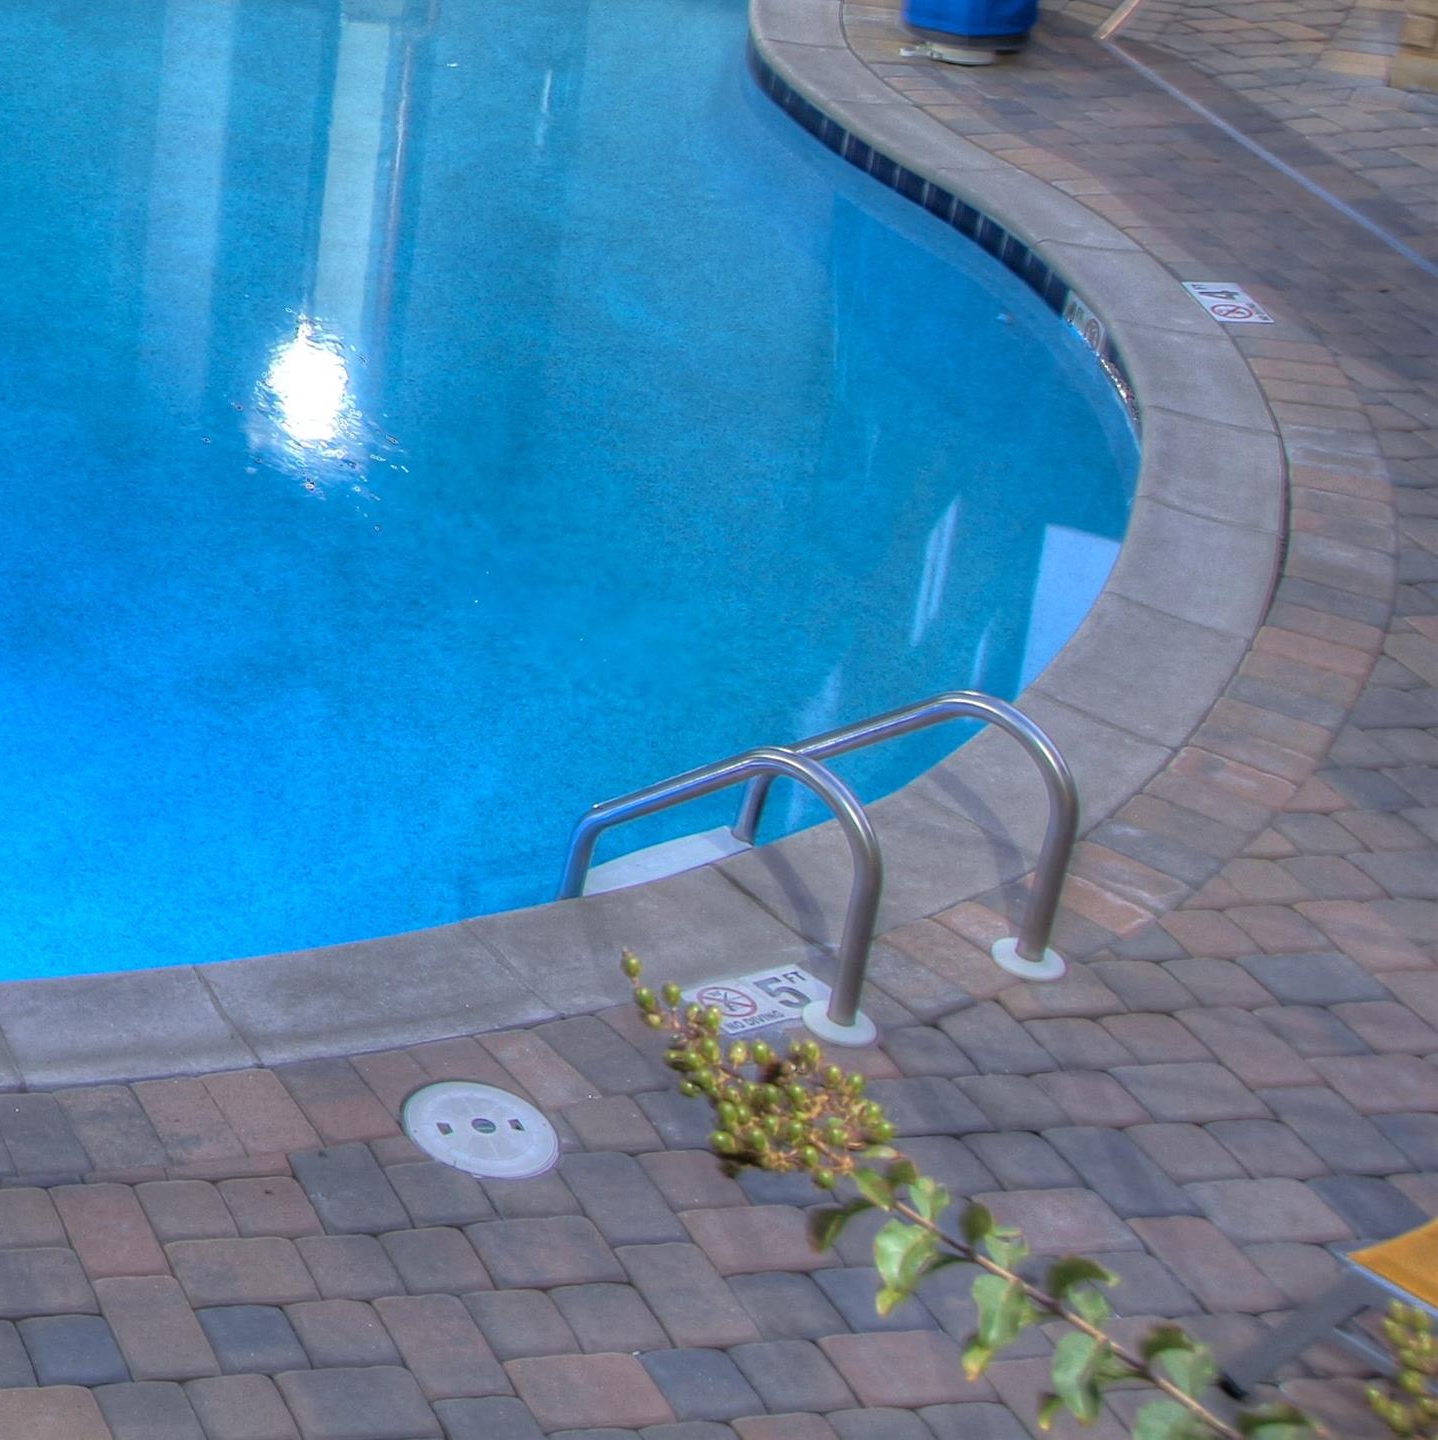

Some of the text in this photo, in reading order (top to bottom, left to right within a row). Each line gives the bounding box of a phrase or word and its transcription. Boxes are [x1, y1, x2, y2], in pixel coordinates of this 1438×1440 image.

[1198, 290, 1240, 300] 4
[753, 970, 812, 1009] 5 FT
[724, 1009, 786, 1032] NO DIVING
